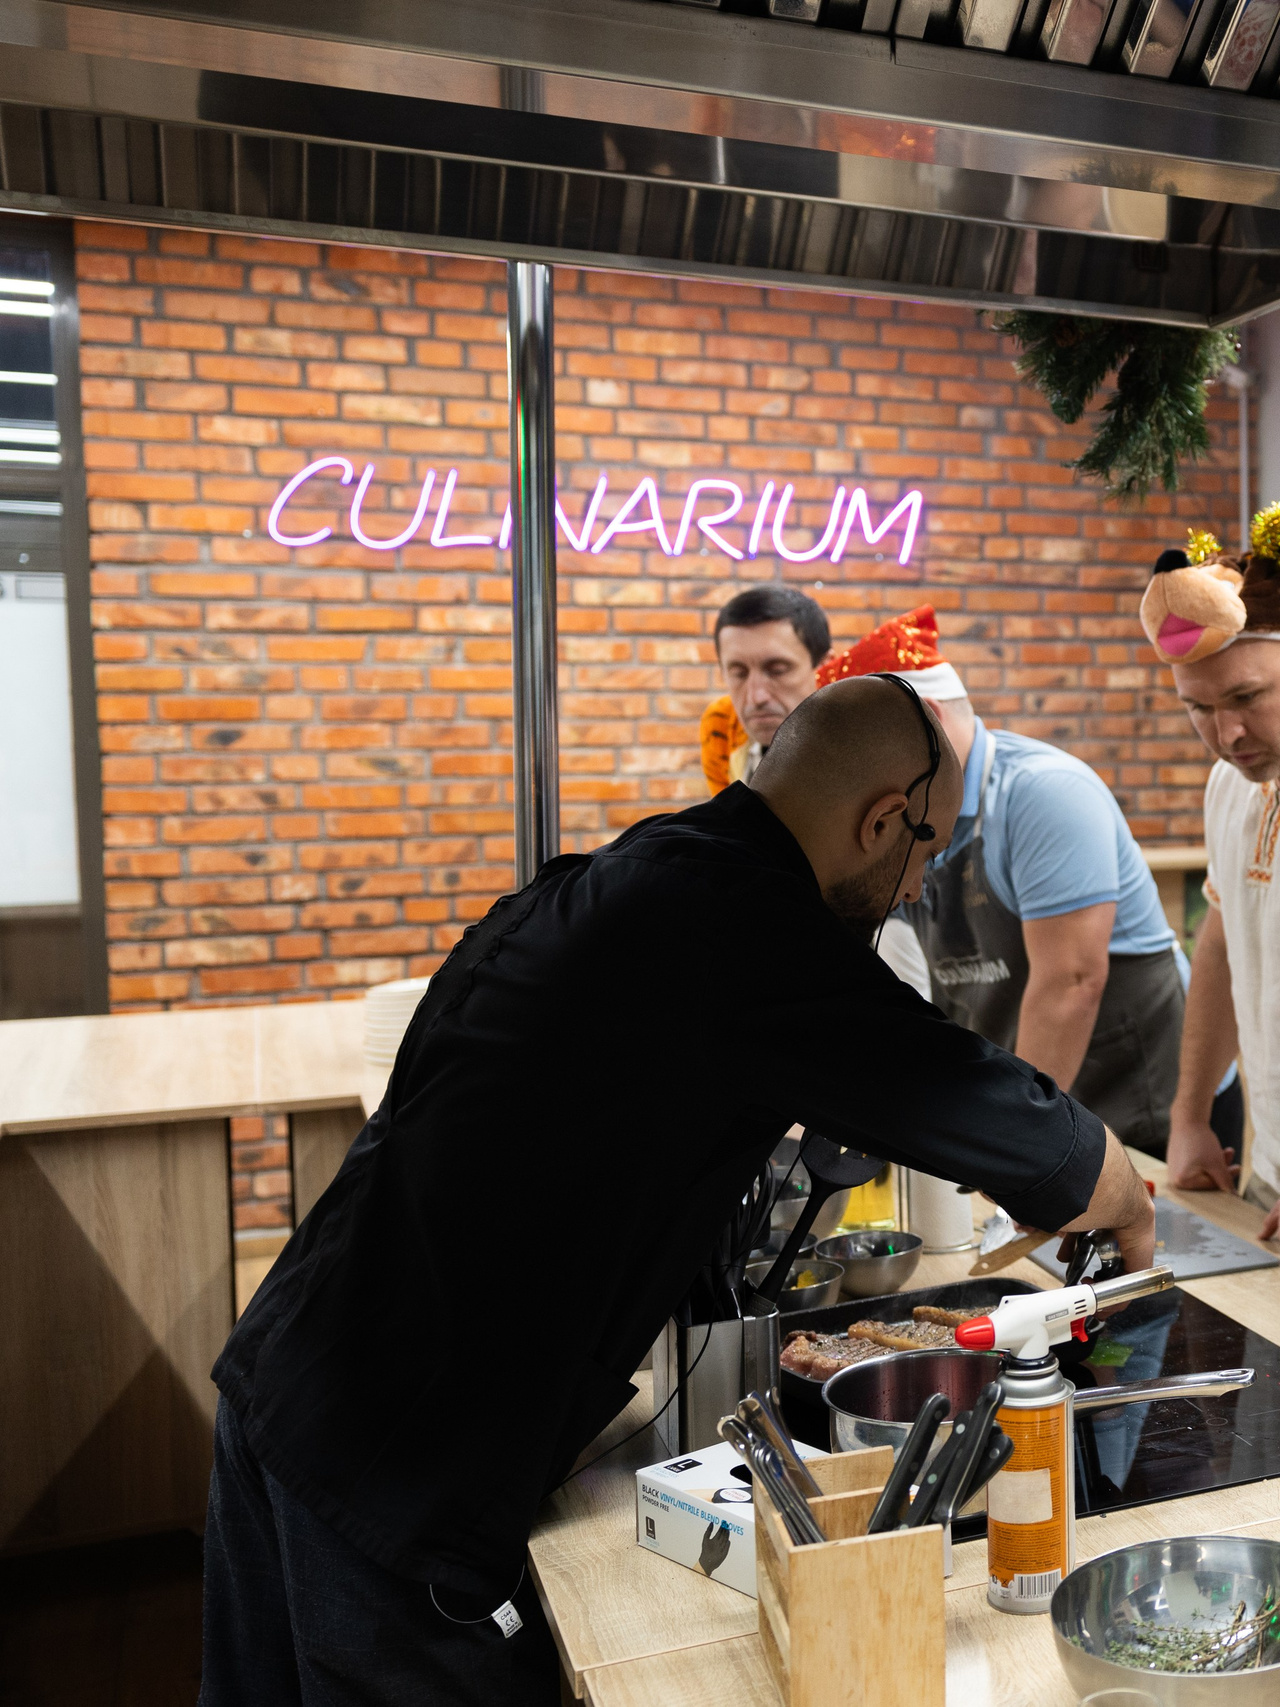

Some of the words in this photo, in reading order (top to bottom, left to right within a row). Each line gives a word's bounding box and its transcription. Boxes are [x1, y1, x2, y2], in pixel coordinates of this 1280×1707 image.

[642, 1494, 660, 1508] POWDER
[660, 1502, 670, 1513] FREE
[642, 1484, 660, 1499] BLACK
[700, 1510, 720, 1525] BLEND
